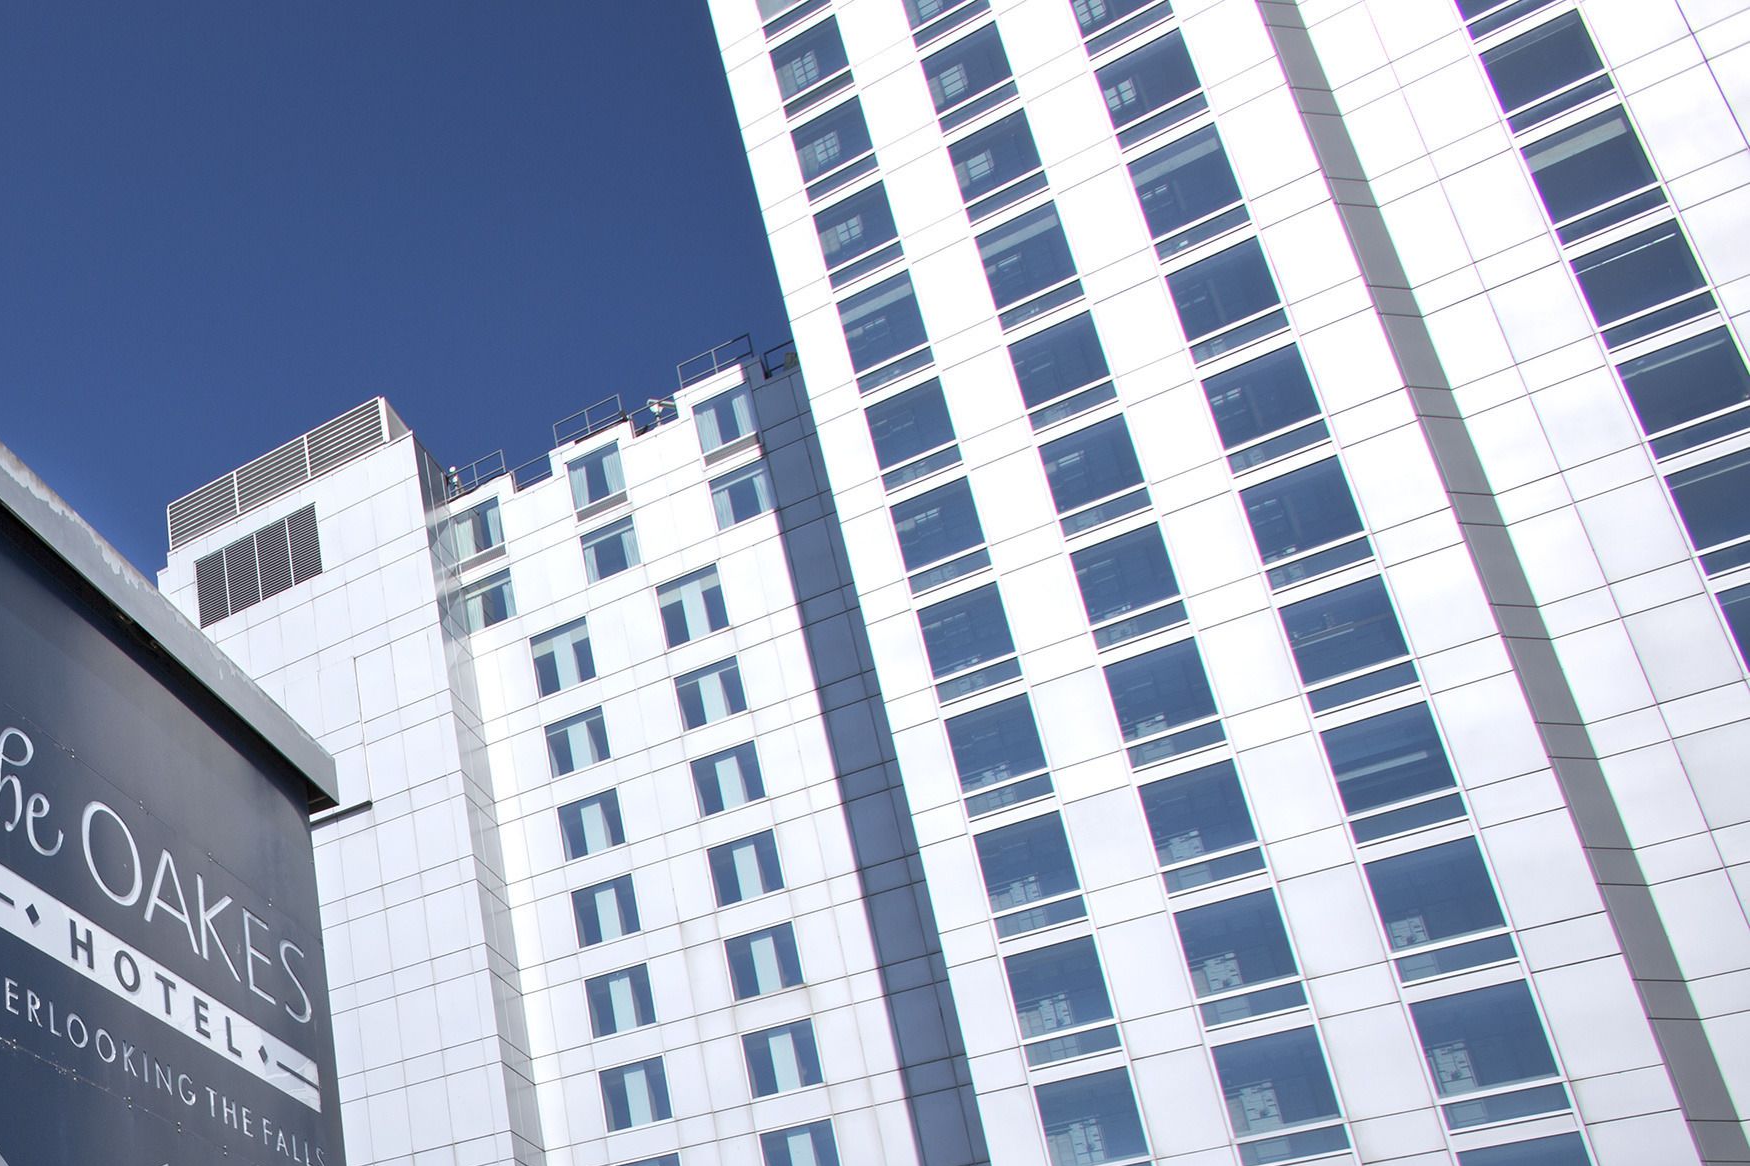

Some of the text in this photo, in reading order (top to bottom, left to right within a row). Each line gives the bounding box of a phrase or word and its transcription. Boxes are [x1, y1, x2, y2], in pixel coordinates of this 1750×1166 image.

[81, 800, 313, 1024] OAKES
[68, 917, 243, 1060] HOTEL
[205, 1084, 255, 1138] THE
